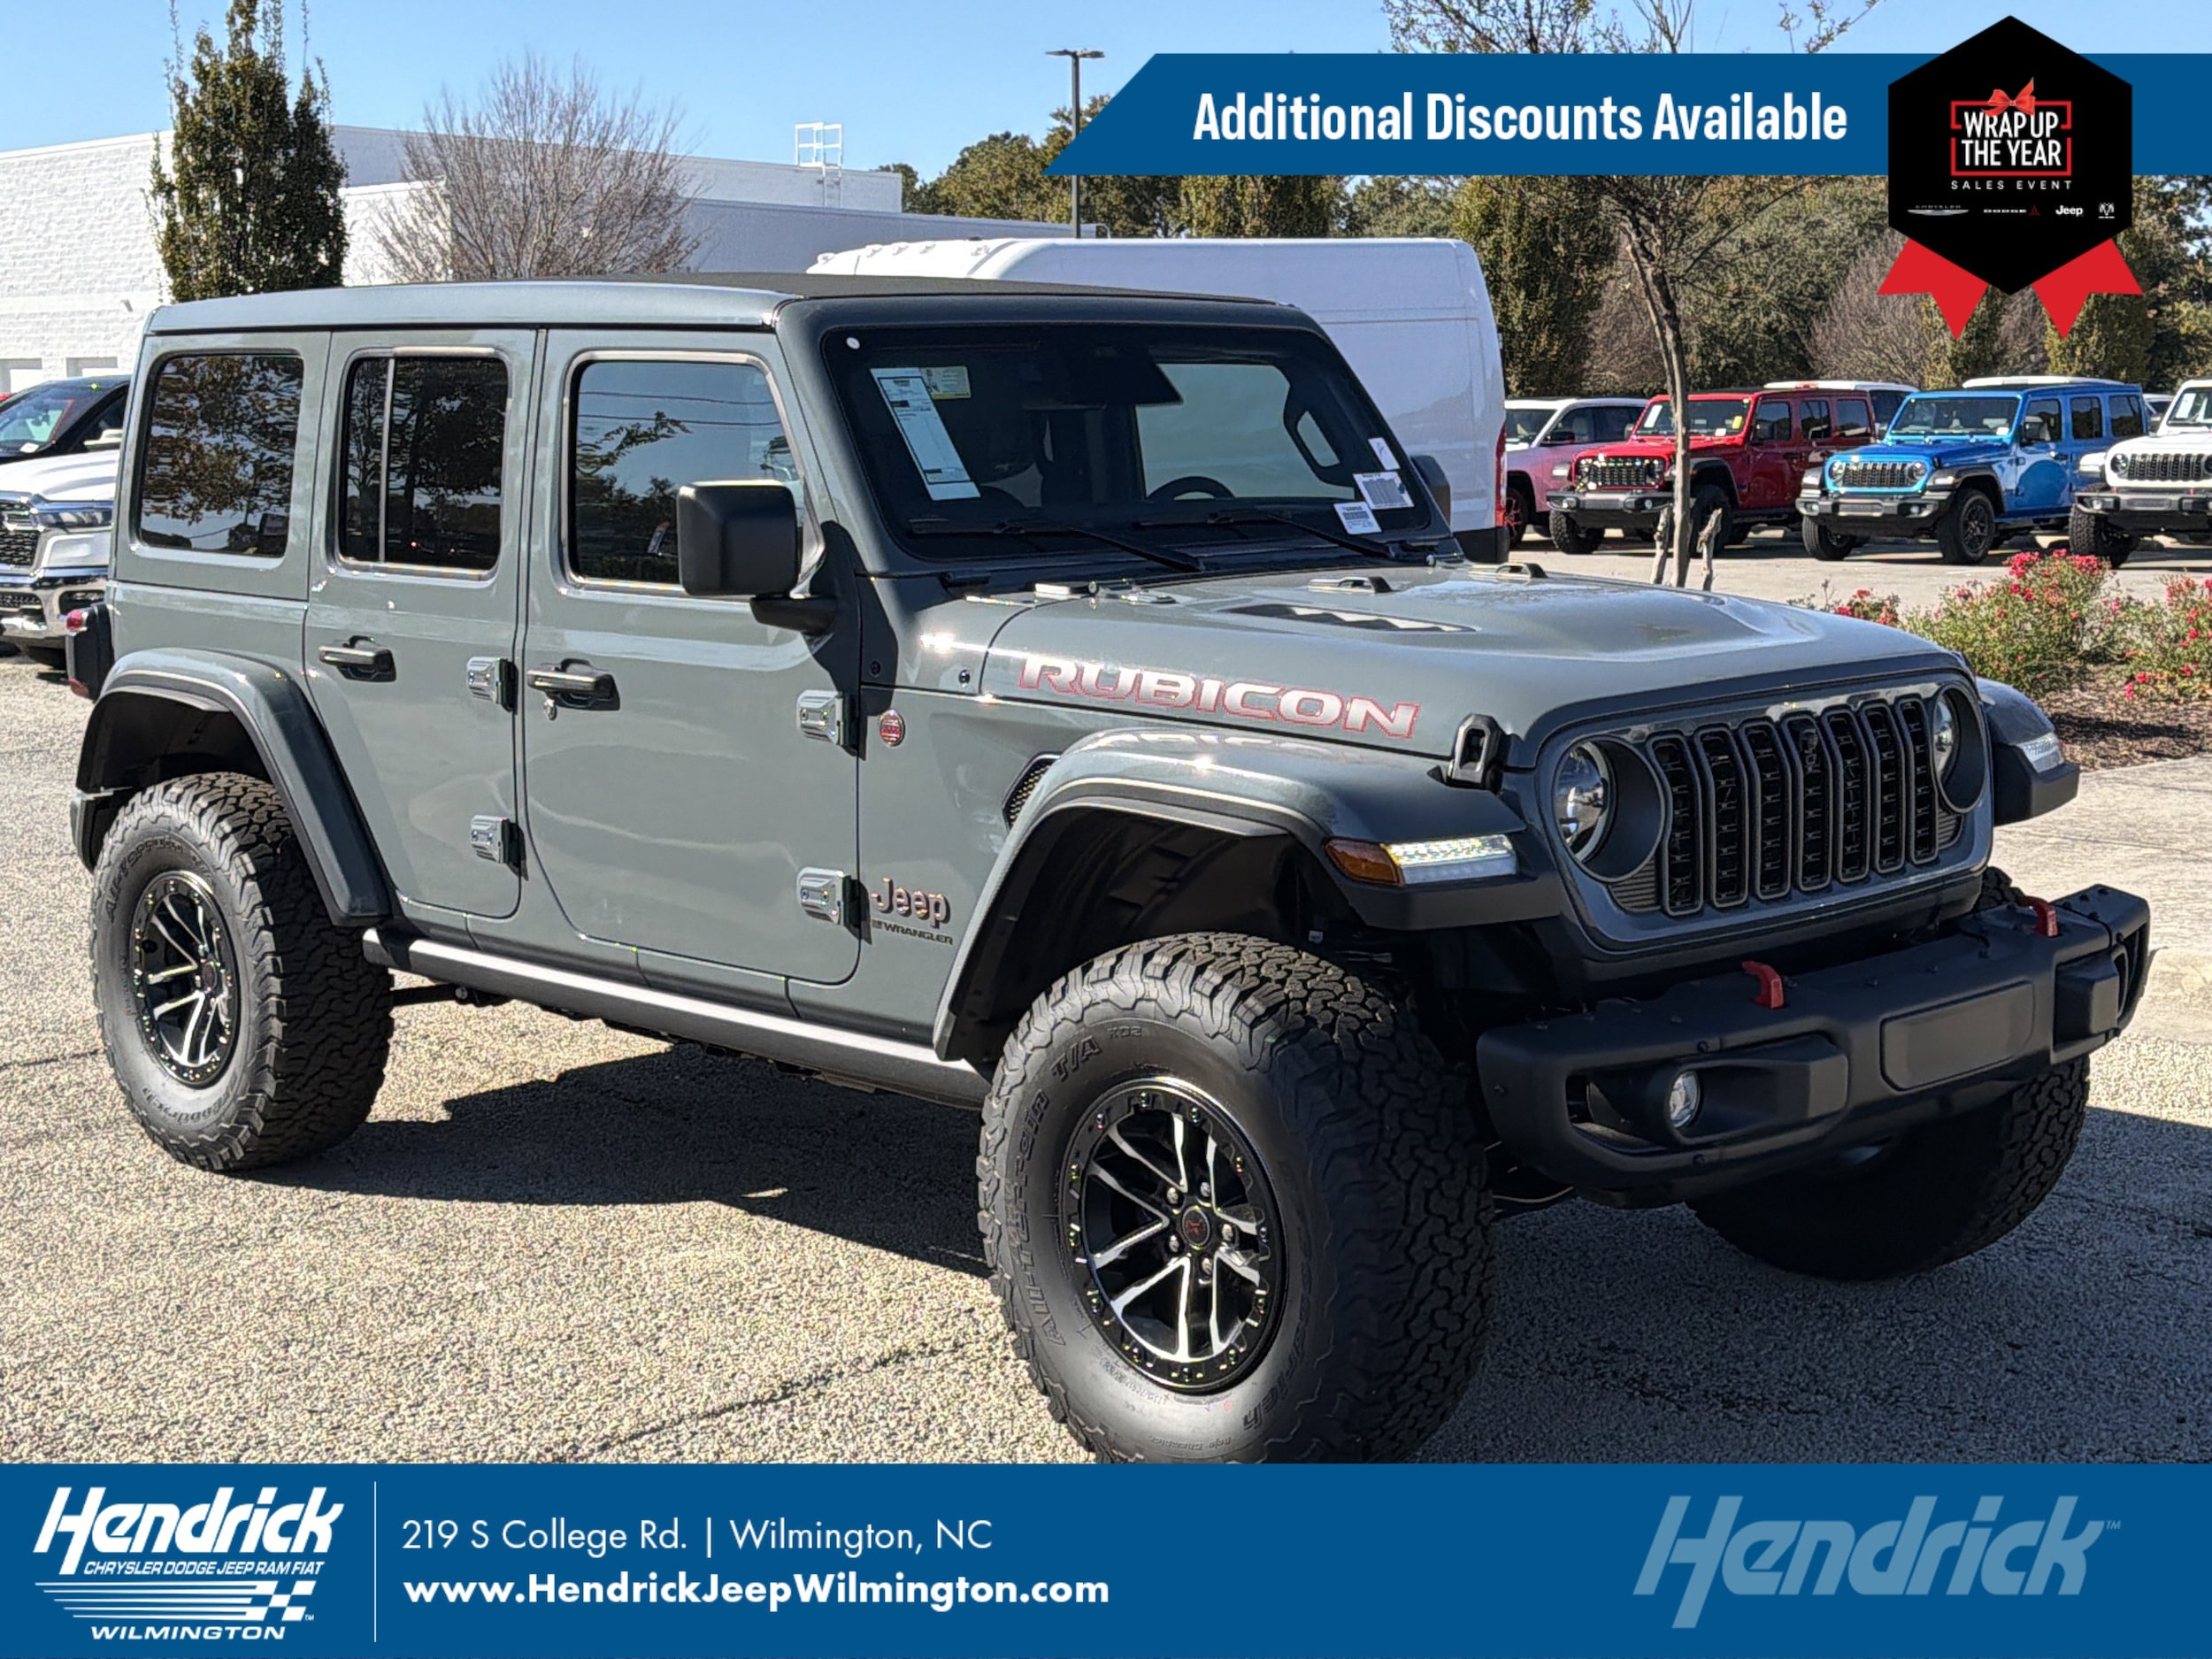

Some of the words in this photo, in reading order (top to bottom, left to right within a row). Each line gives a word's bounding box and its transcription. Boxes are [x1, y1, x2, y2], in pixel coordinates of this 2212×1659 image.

[1017, 657, 1421, 740] RUBICON
[871, 877, 951, 929] Jeep
[884, 921, 953, 945] WRANGLER
